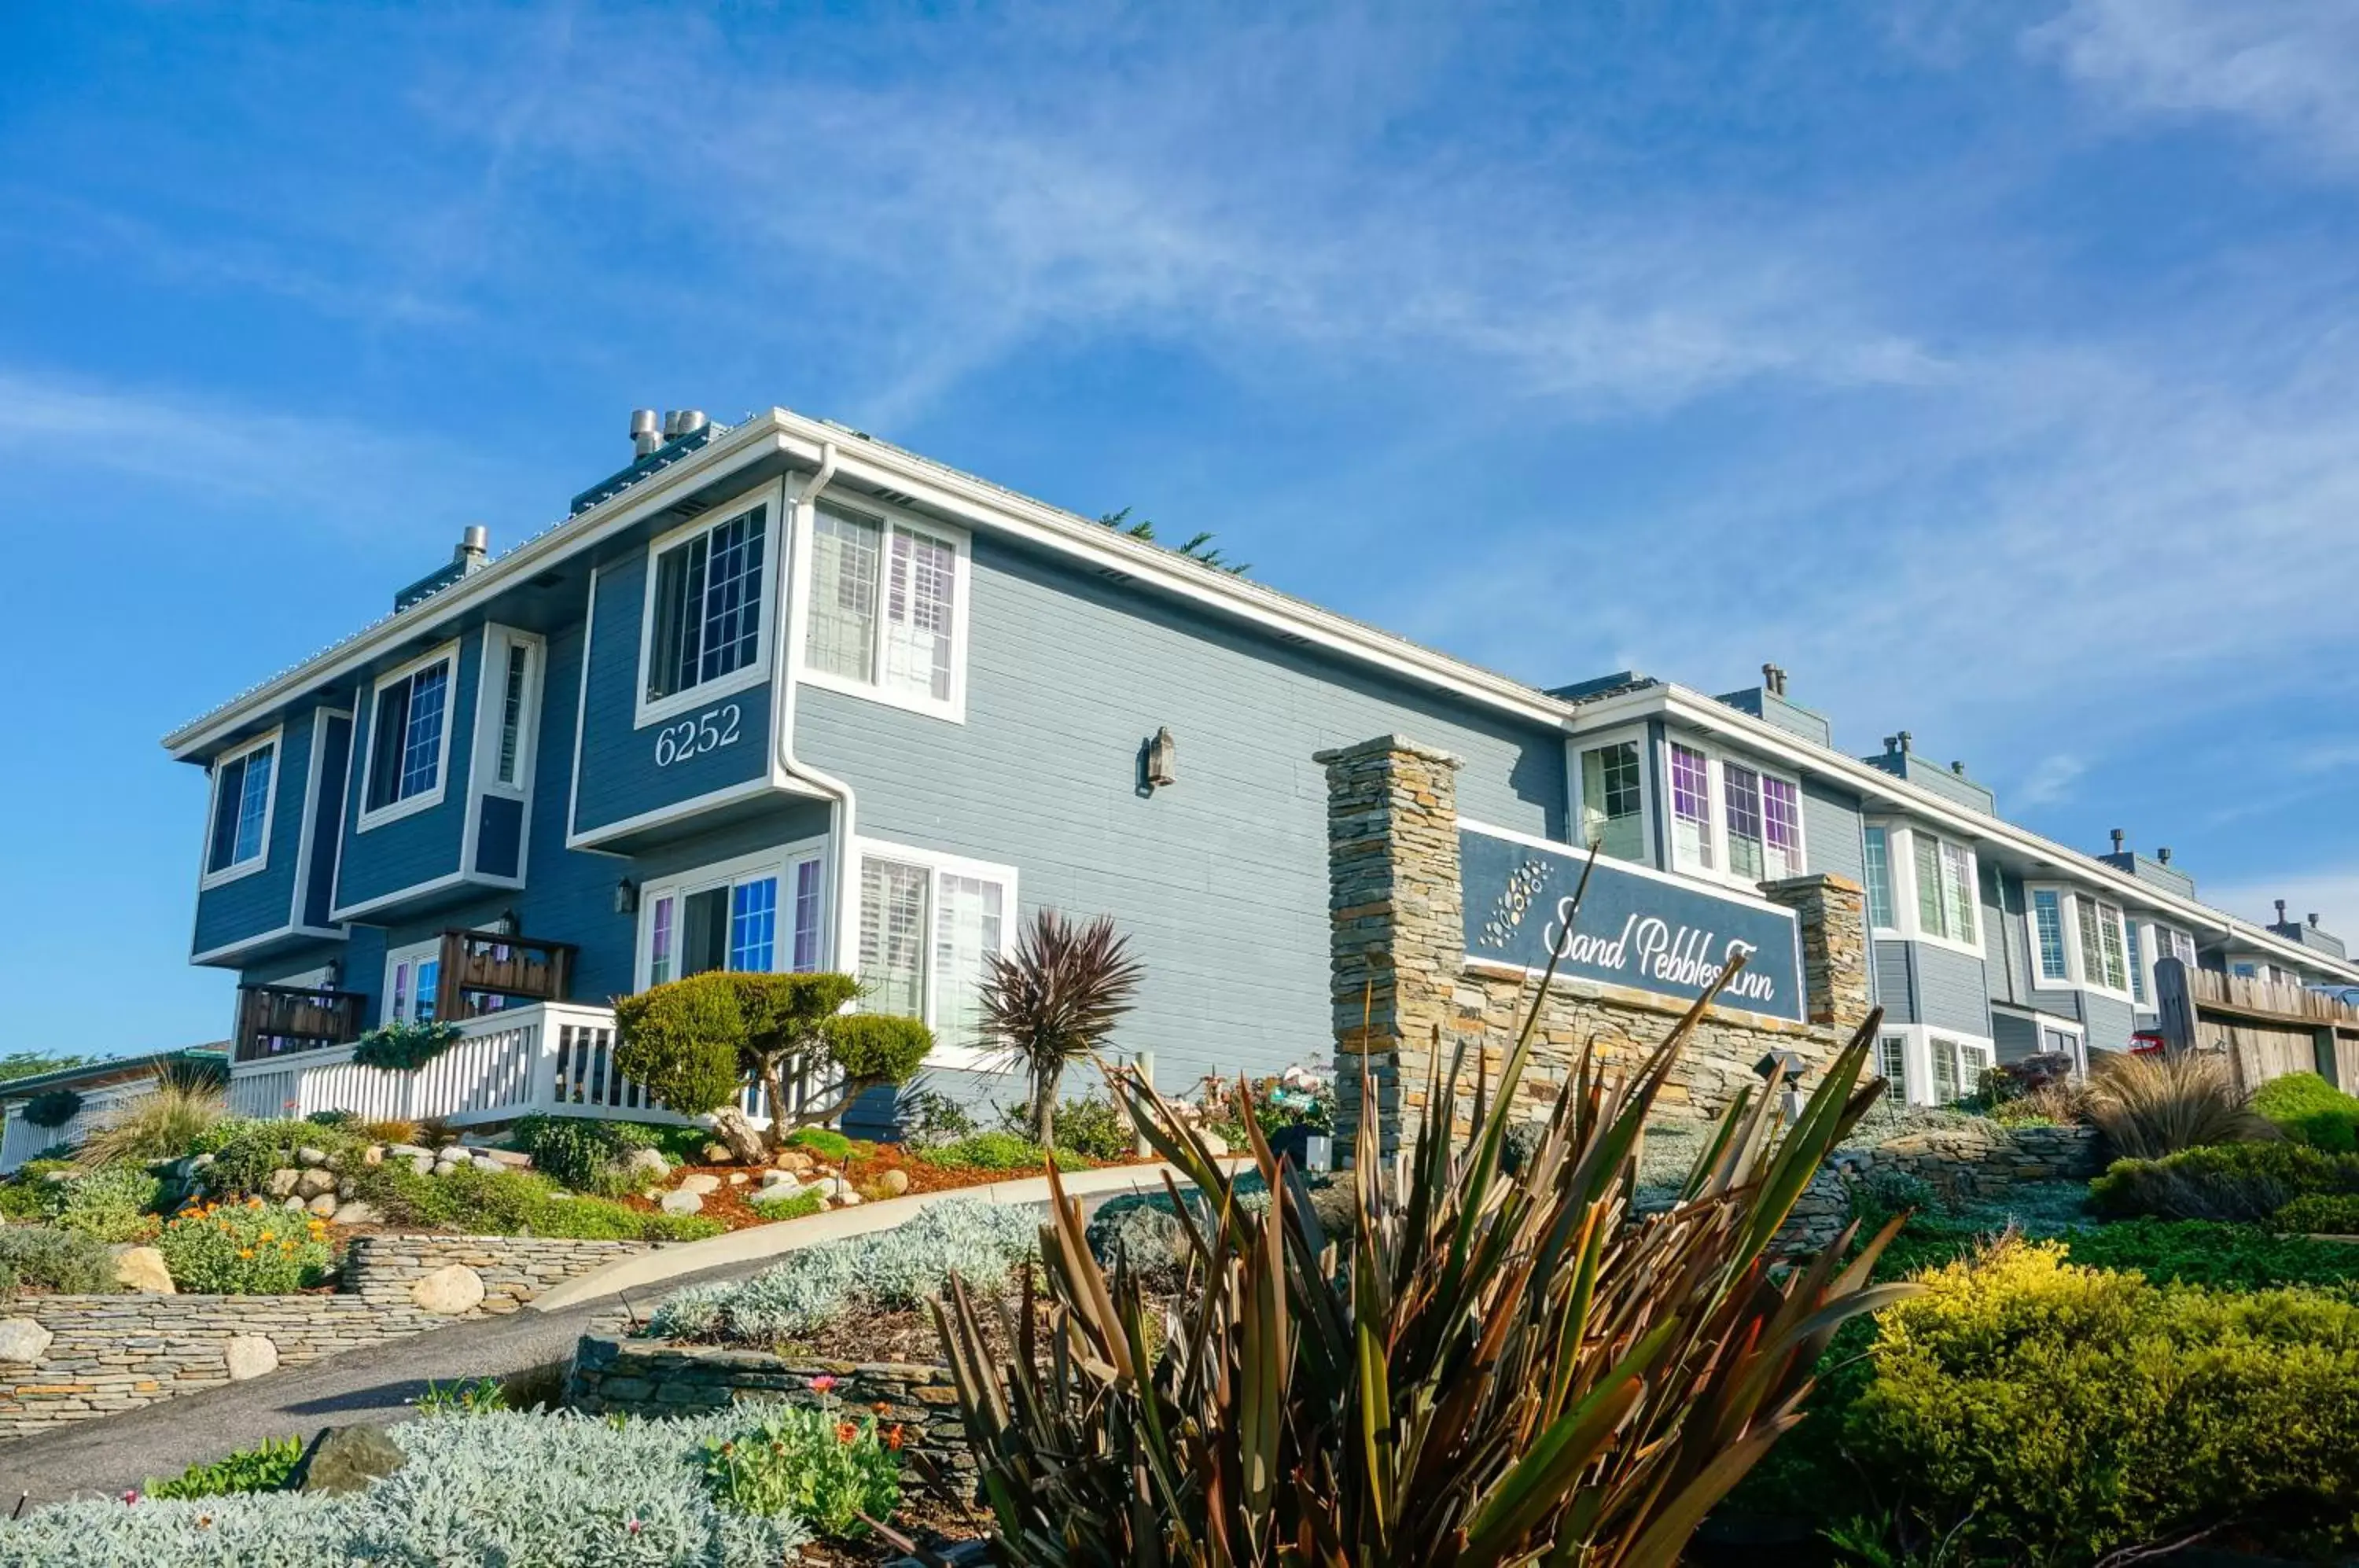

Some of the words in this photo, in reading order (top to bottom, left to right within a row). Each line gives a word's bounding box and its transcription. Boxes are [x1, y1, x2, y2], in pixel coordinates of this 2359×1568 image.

[655, 704, 741, 767] 6252
[1544, 896, 1638, 970] Sand
[1638, 918, 1722, 988] Pebbles
[1724, 940, 1774, 1002] Inn
